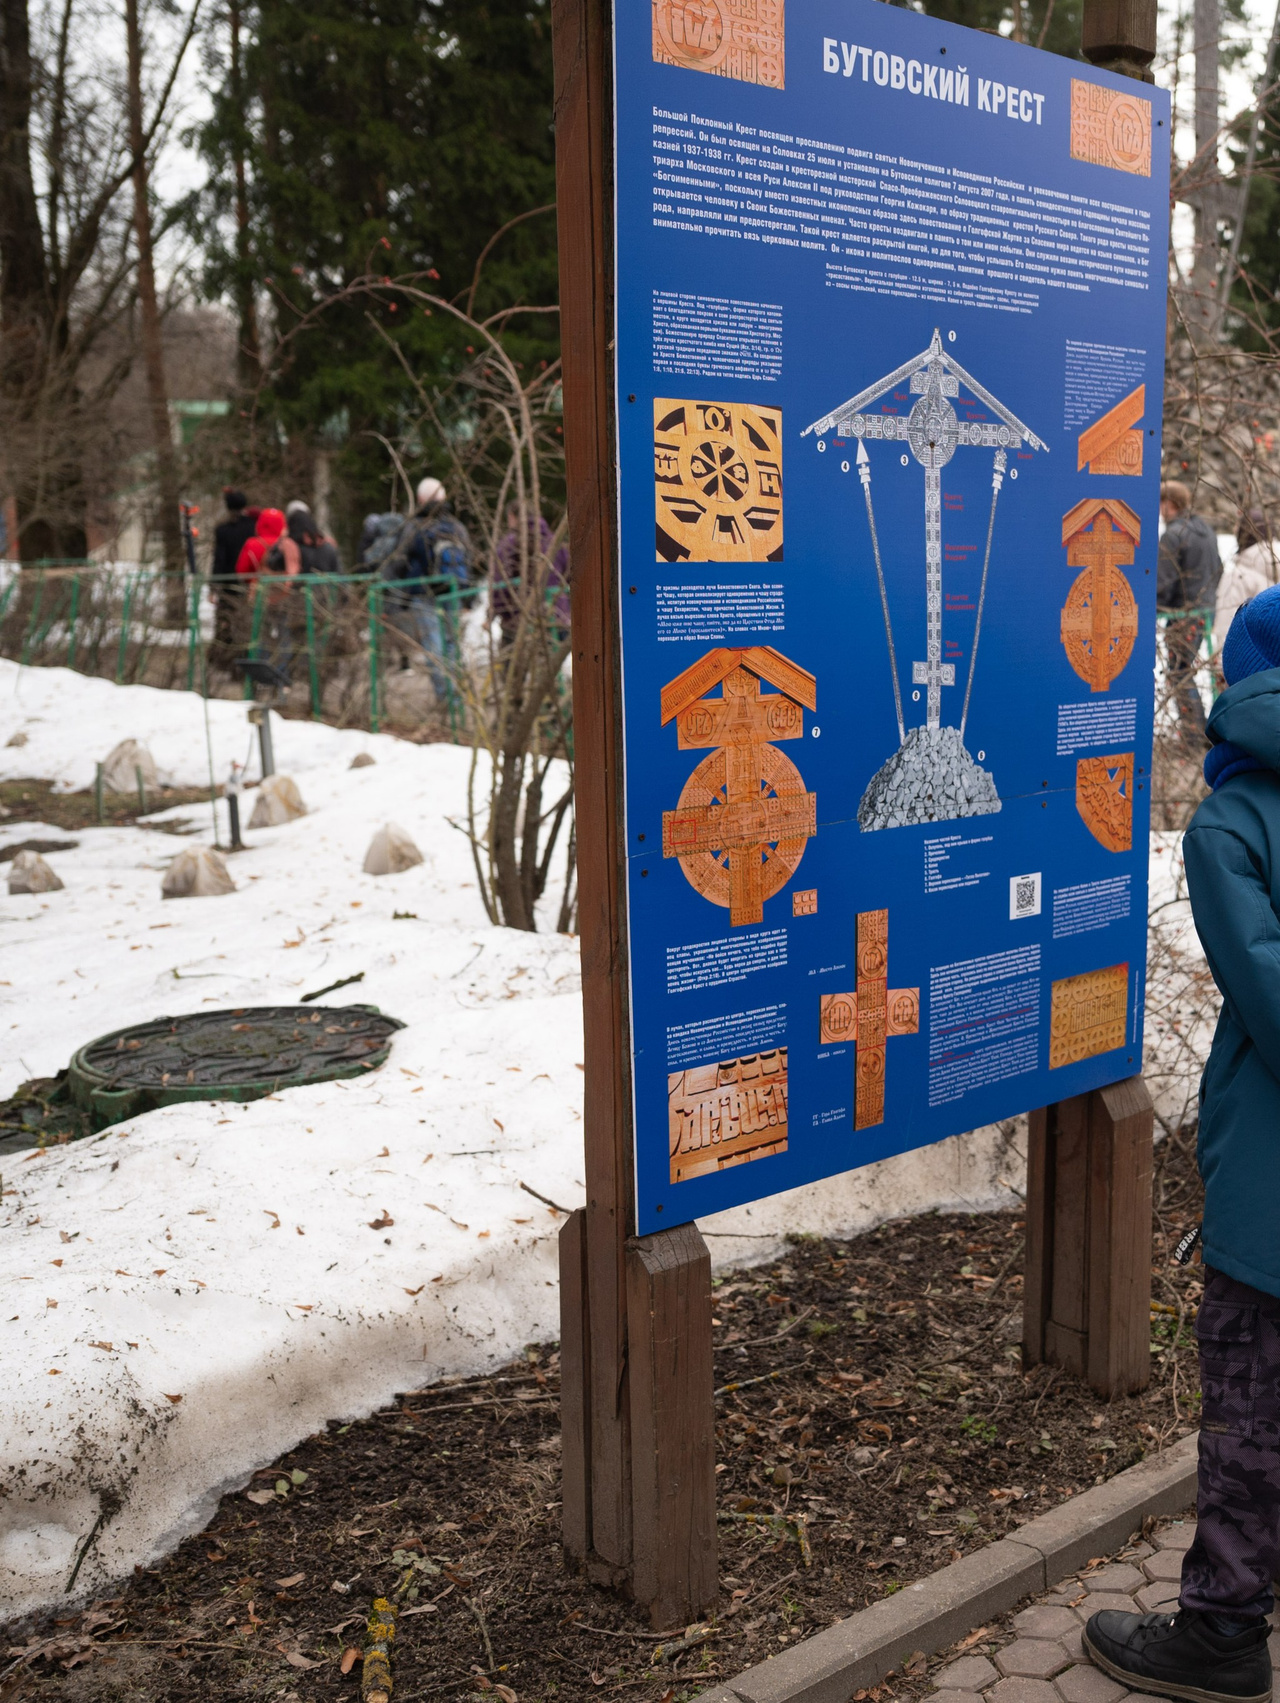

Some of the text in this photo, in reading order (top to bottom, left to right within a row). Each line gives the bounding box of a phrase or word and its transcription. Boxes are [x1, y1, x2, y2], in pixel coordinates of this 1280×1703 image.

[823, 37, 1045, 125] БУТОВСКИЙ КРЕСТ
[653, 106, 688, 122] Большой
[691, 114, 733, 131] Поклонный
[736, 123, 756, 135] Крест
[759, 130, 793, 143] посвящен
[796, 137, 844, 153] прославлению
[847, 148, 873, 159] подвига
[875, 153, 897, 164] святых
[899, 157, 944, 174] Новомучеников
[653, 124, 696, 139] репрессий.
[699, 131, 708, 141] Он
[711, 134, 726, 145] был
[729, 139, 760, 151] освящен
[762, 145, 770, 153] на
[773, 145, 805, 160] Соловках
[807, 152, 815, 162] 25
[818, 156, 835, 166] июля
[844, 161, 879, 174] установлен
[891, 169, 922, 183] Бутовском
[653, 140, 680, 151] казней
[683, 144, 721, 159] 1937-1938
[724, 153, 733, 161] гг.
[736, 153, 757, 166] Крест
[759, 160, 783, 171] создан
[792, 166, 837, 180] кресторезной
[839, 175, 876, 188] мастерской
[653, 156, 683, 168] триарха
[687, 160, 735, 177] Московского
[745, 172, 761, 181] всея
[764, 174, 780, 185] Руси
[783, 177, 811, 190] Алексия
[813, 183, 818, 191] II
[820, 186, 832, 195] под
[835, 189, 878, 202] руководством
[881, 195, 905, 207] Георгия
[907, 200, 938, 214] Кожокаря,
[653, 170, 722, 191] «Богоименными»,
[725, 184, 762, 198] поскольку
[765, 191, 789, 201] вместо
[791, 195, 826, 208] известных
[829, 202, 871, 215] иконописных
[873, 209, 898, 220] образов
[900, 214, 917, 223] здесь
[653, 187, 702, 201] открывается
[705, 196, 738, 209] человеку
[746, 200, 767, 212] Своих
[770, 204, 819, 221] Божественных
[821, 215, 847, 225] именах.
[849, 218, 867, 229] Часто
[869, 223, 891, 233] кресты
[893, 227, 928, 239] воздвигали
[653, 203, 674, 214] рода,
[677, 207, 721, 220] направляли
[724, 214, 737, 222] или
[740, 216, 797, 232] предостерегали.
[800, 224, 819, 235] Такой
[822, 230, 840, 238] крест
[842, 233, 870, 243] является
[872, 238, 905, 249] раскрытой
[907, 244, 929, 254] книгой,
[653, 218, 702, 232] внимательно
[705, 226, 741, 238] прочитать
[744, 232, 760, 241] вязь
[762, 235, 799, 247] церковных
[801, 241, 827, 251] молитв.
[831, 243, 839, 253] Он
[846, 248, 864, 257] икона
[872, 252, 911, 264] молитвослов
